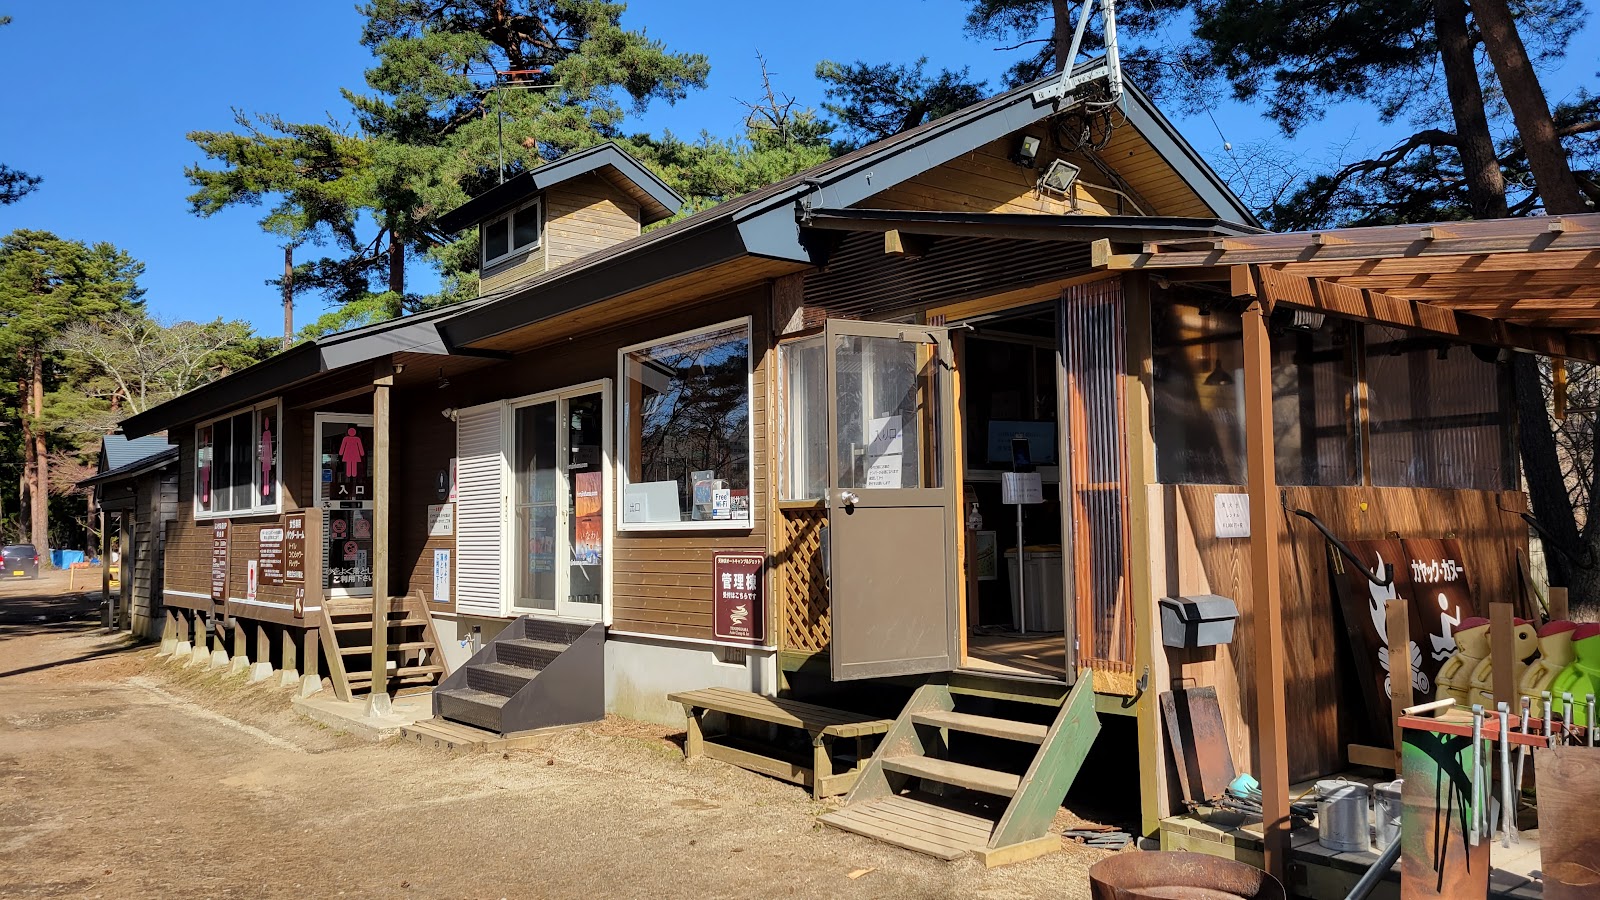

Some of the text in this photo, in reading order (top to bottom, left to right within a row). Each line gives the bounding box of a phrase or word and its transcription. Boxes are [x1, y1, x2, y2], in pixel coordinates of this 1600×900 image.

[873, 428, 897, 443] 入り口
[338, 484, 365, 495] 入口
[715, 493, 728, 501] Free
[715, 500, 728, 508] Wi-Fi
[721, 572, 757, 591] 管理棟
[722, 591, 757, 600] 受付はこちらです
